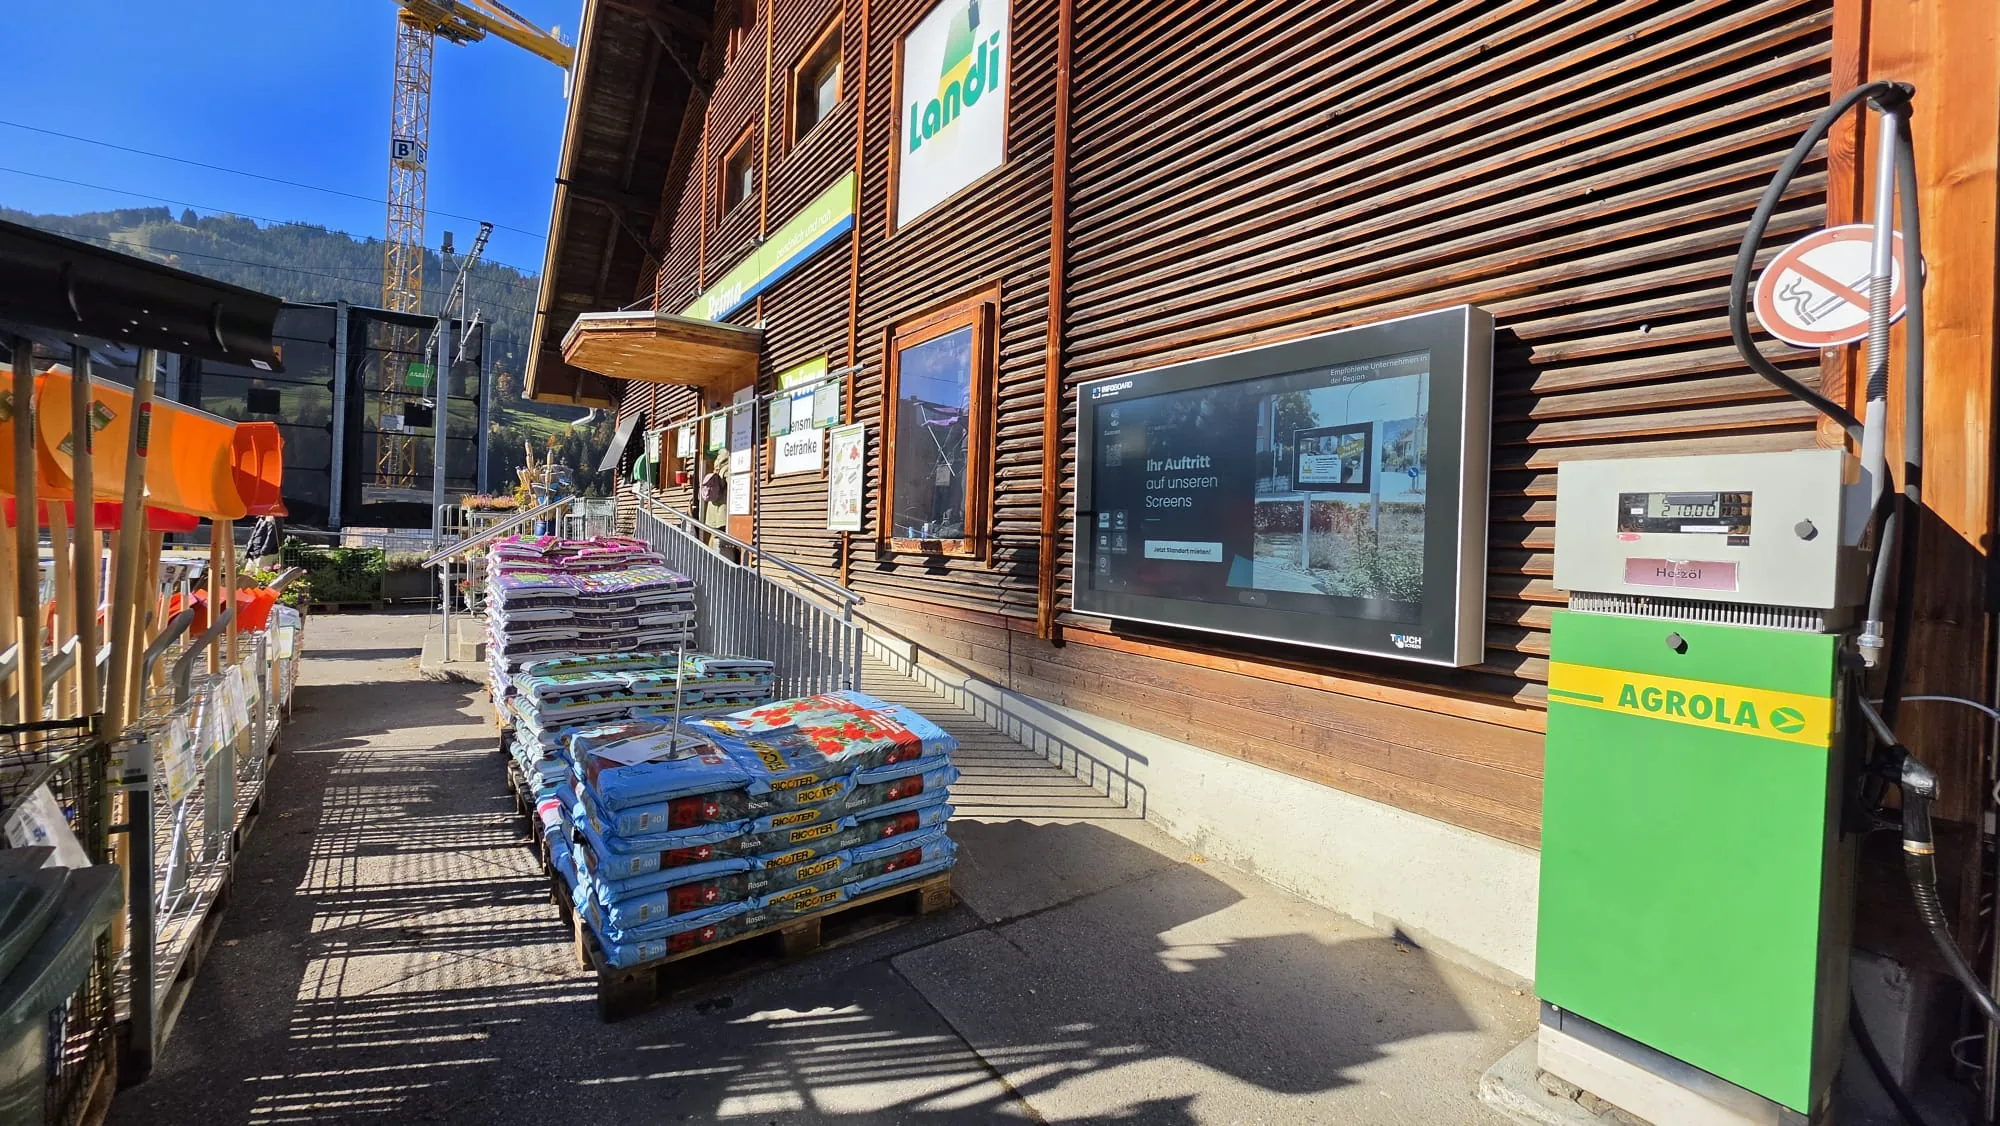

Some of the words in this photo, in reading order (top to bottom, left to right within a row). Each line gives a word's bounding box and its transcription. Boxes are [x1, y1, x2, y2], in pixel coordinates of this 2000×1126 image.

[909, 30, 1000, 154] Landi
[398, 143, 410, 156] B
[1330, 364, 1369, 377] Empfohlene
[1370, 357, 1419, 371] Unternehmen
[1342, 374, 1365, 383] Region
[783, 439, 817, 457] Getränke
[1146, 459, 1162, 471] Ihr
[1164, 455, 1211, 471] Auftritt
[1146, 476, 1165, 490] auf
[1167, 476, 1218, 489] unseren
[1145, 495, 1192, 508] Screens
[1617, 683, 1760, 729] AGROLA
[770, 776, 813, 791] RICOTER
[772, 811, 815, 828] RICOTER
[791, 823, 833, 840] RICOTER
[741, 840, 761, 849] Rosen
[766, 851, 809, 869] RICOTER
[798, 859, 838, 879] RICOTER
[748, 879, 768, 889] Rosen
[795, 891, 837, 911] RICOTER
